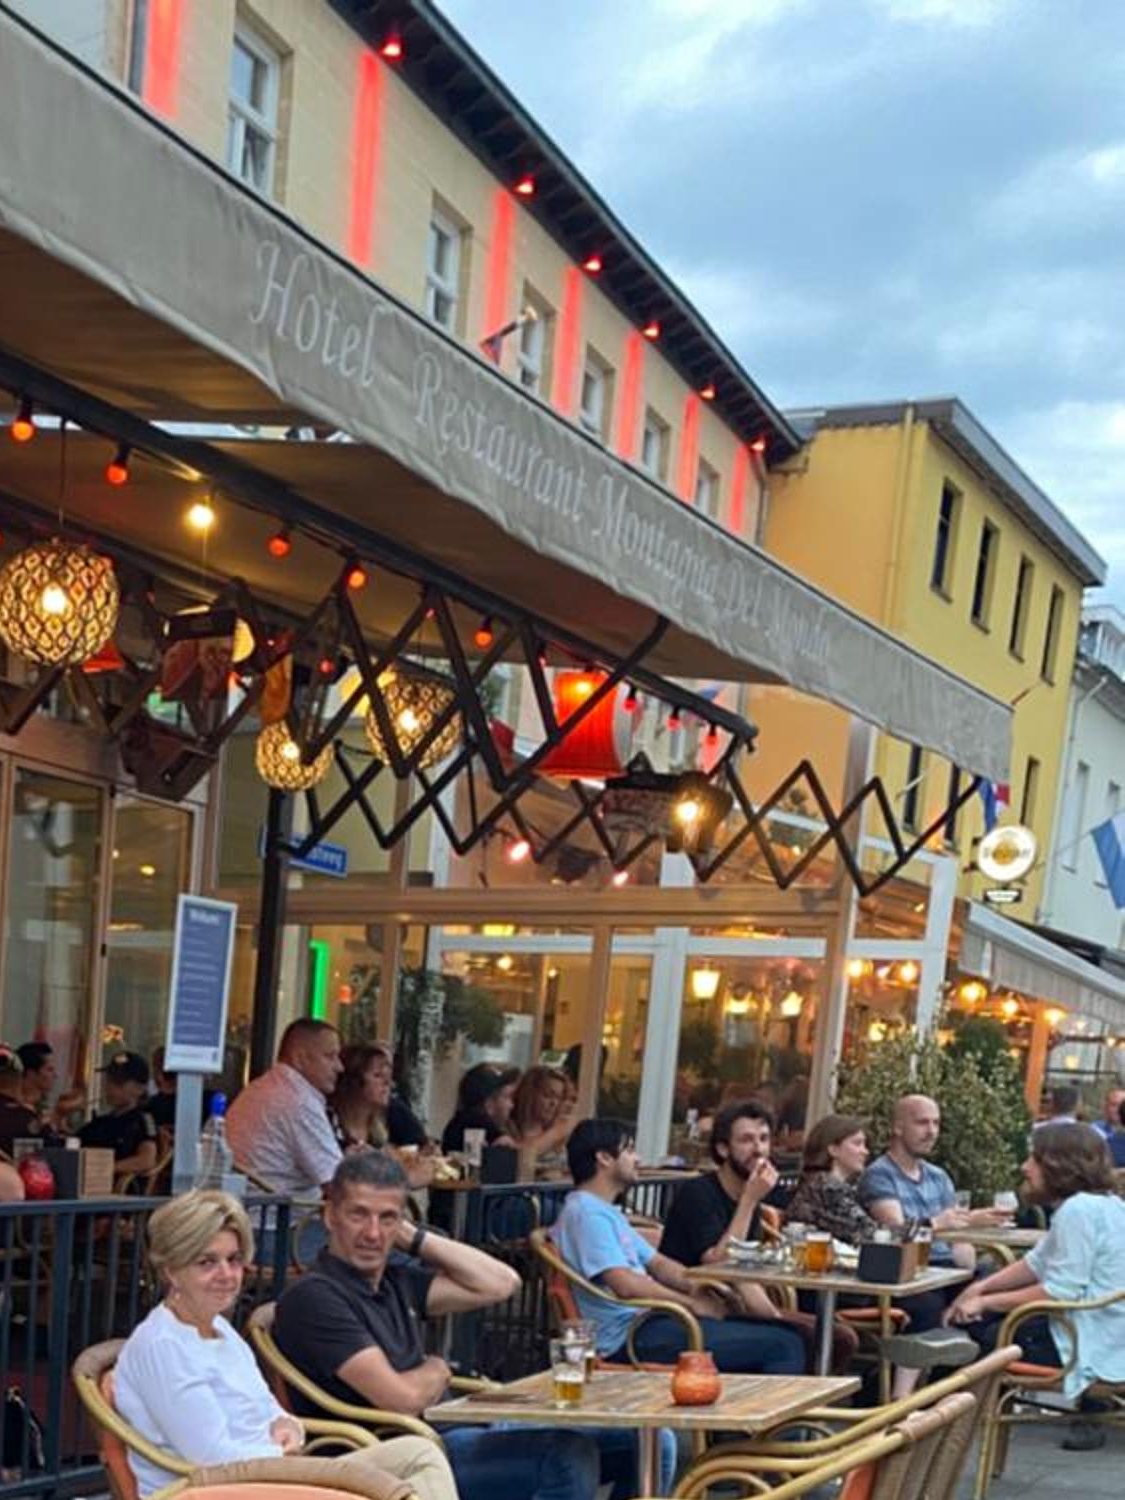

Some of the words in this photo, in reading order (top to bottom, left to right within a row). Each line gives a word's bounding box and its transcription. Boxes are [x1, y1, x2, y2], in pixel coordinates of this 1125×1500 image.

[248, 239, 394, 387] Hotel
[412, 351, 588, 521] Restaurant
[592, 472, 717, 611] Montagna
